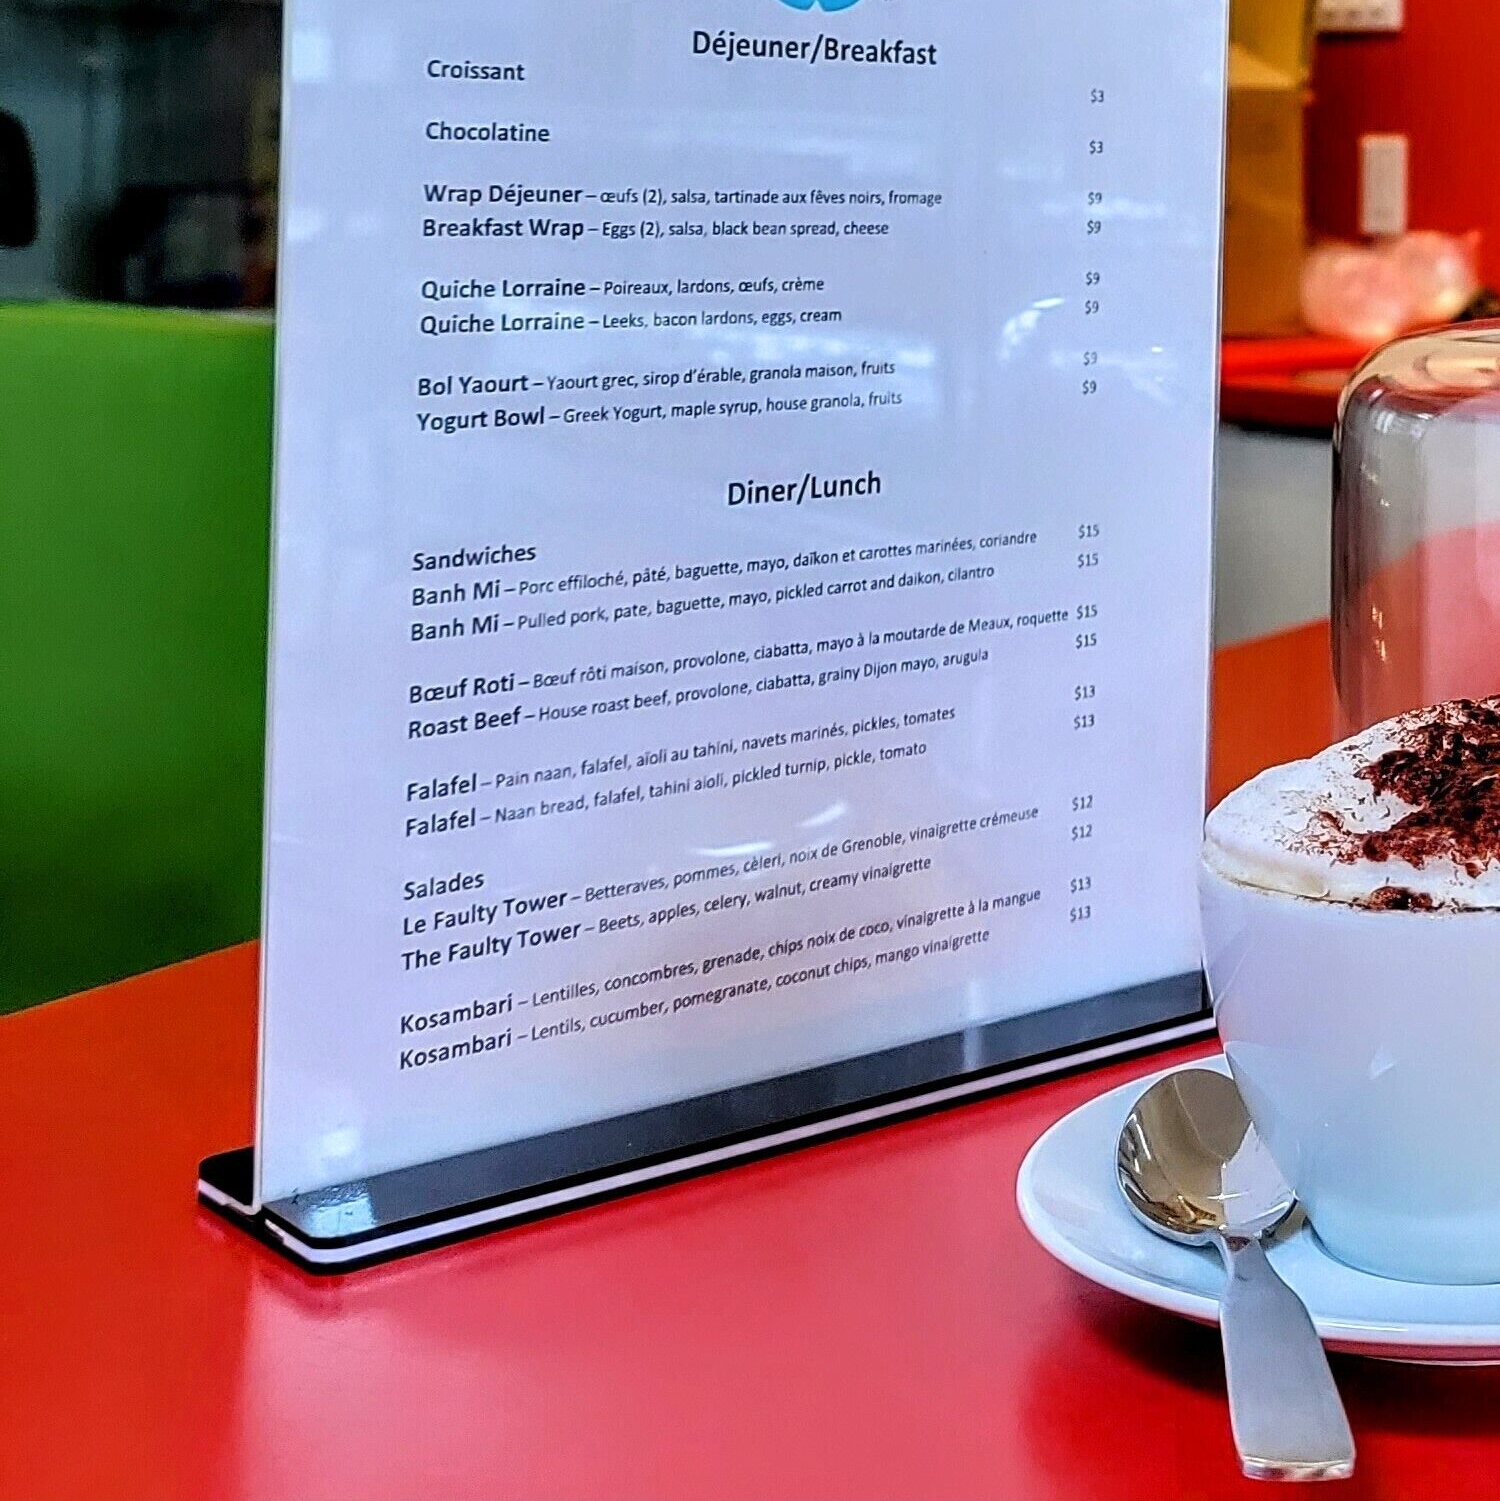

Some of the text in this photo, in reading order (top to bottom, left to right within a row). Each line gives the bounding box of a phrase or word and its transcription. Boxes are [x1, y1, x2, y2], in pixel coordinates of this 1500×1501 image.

[692, 29, 938, 66] Déjeuner/Breakfast
[426, 59, 526, 82] Croissant
[1090, 87, 1105, 104] $3
[425, 120, 551, 143] Chocolatine
[1088, 139, 1104, 156] $3
[423, 183, 483, 207] Wrap
[488, 182, 583, 207] Déjeuner
[599, 187, 639, 204] œufs
[642, 187, 668, 207] (2),
[670, 188, 711, 206] salsa,
[714, 188, 780, 205] tartinade
[781, 192, 808, 204] aux
[848, 190, 886, 207] noirs,
[888, 189, 943, 208] fromage
[422, 216, 890, 241] Breakfast Wrap Eggs (2), salsa, black bean spread, cheese
[1086, 219, 1102, 236] $9
[421, 275, 825, 302] Quiche Lorraine Poireaux, lardons, œufs, crème
[1085, 270, 1101, 287] $9
[1084, 299, 1100, 316] $9
[420, 310, 843, 337] Quiche Lorraine bacon lardons, eggs, cream
[417, 375, 454, 397] Bol
[458, 374, 530, 395] Yaourt
[546, 374, 599, 391] Yaourt
[601, 374, 639, 392] grec,
[641, 370, 680, 388] sirop
[748, 363, 802, 385] granola
[804, 364, 858, 379] maison,
[1082, 379, 1098, 396] $9
[415, 392, 865, 435] Yogurt Bowl Greek Yogurt, maple syrup, house granola,
[727, 469, 882, 507] Diner/Lunch
[1078, 523, 1100, 540] $15
[411, 543, 537, 572] Sandwiches
[411, 530, 1038, 607] Banh Mi Porc effiloché, pâté, baguette, mayo, carottes coriandre
[1077, 552, 1099, 570] $15
[410, 566, 995, 642] Banh Mi Pulled pork, pate, baguette, mayo, pickled carrot and cilantro
[1076, 603, 1099, 621] $15
[1075, 632, 1098, 650] $15
[409, 677, 469, 705] Bœuf
[472, 672, 516, 697] Roti
[532, 667, 578, 689] Bœuf
[610, 660, 669, 679] maison,
[672, 650, 750, 675] provolone,
[753, 642, 813, 660] ciabatta,
[816, 637, 854, 653] mayo
[883, 622, 947, 644] moutarde
[968, 617, 1014, 633] Meaux,
[1016, 609, 1069, 628] roquette
[407, 657, 939, 740] Roast Beef House roast beef, provolone, ciabatta, grainy Dijon mayo,
[1074, 684, 1096, 702] $13
[1073, 713, 1095, 731] $13
[406, 707, 956, 803] Falafel Pain naan, falafel, tahini, navets pickles, tomates
[1071, 794, 1094, 812] $12
[405, 806, 477, 838] Falafel
[1071, 823, 1093, 843] $12
[402, 871, 485, 901] Salades
[403, 819, 977, 936] Le Faulty Tower Betteraves, pommes, Grenoble, vinaigrette
[1070, 875, 1092, 895] $13
[400, 857, 932, 971] The Faulty Tower Beets, apples, celery, walnut, creamy vinaigrette
[1069, 904, 1092, 924] $13
[400, 905, 965, 1035] Kosambari Lentilles, concombres, grenade, chips vinaigrette
[399, 930, 990, 1071] Kosambari Lentils, cucumber, pomegranate, coconut chips, mango vinaigrette
